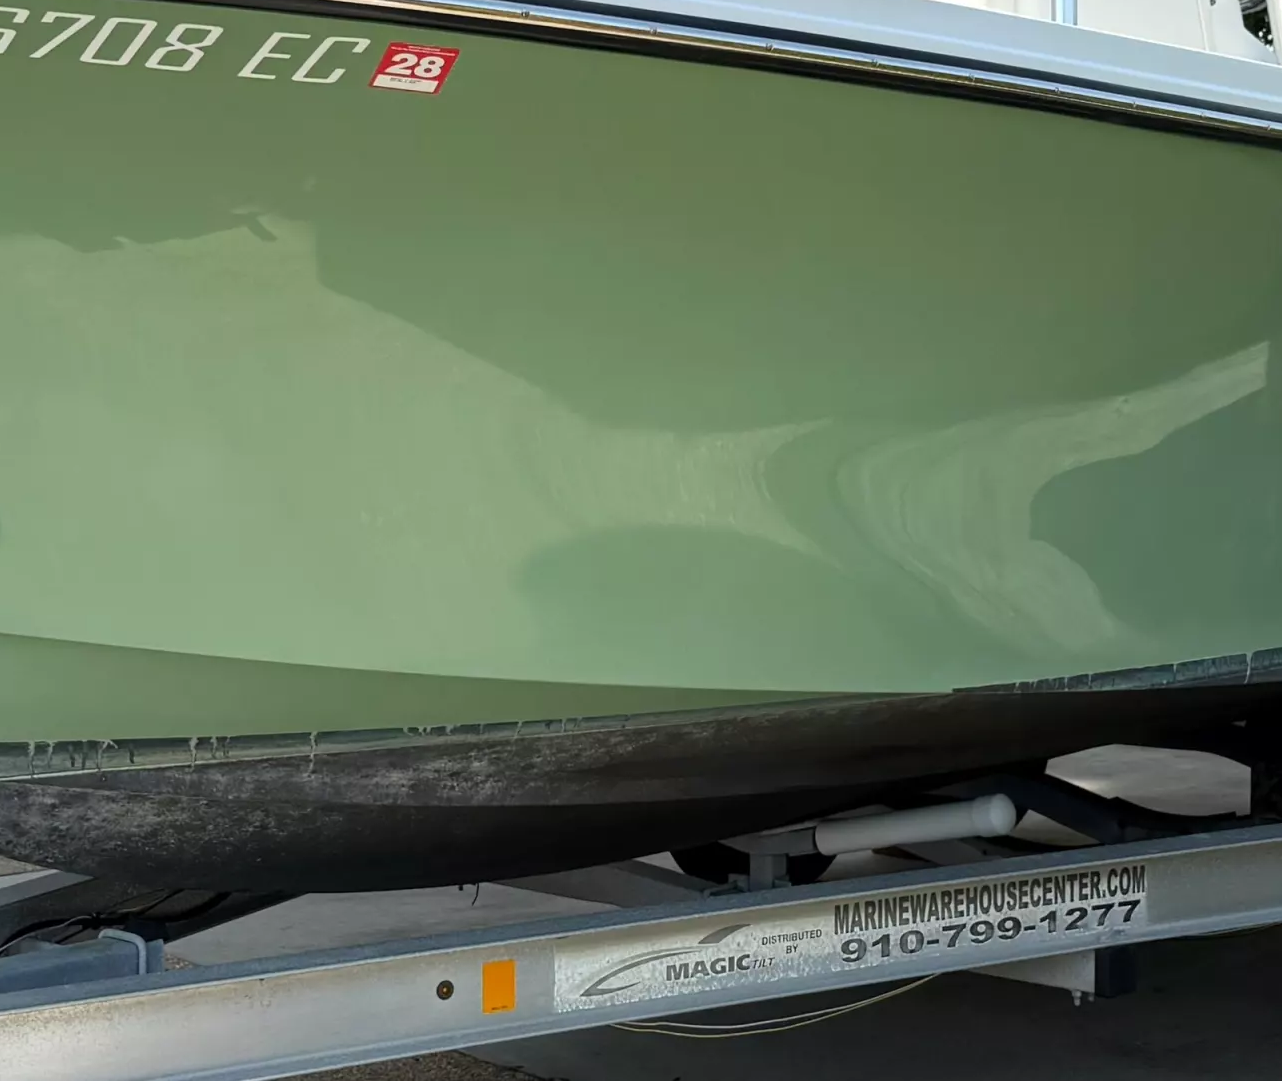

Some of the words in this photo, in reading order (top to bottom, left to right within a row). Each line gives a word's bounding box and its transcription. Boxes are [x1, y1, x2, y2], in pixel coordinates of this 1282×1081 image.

[237, 32, 371, 85] EC
[384, 53, 445, 78] 28
[834, 865, 1146, 935] MARINEWAREHOUSECENTER.COM
[761, 928, 823, 946] DISTRIBUTED
[840, 899, 1141, 963] 910-799-1277
[785, 944, 799, 954] BY
[665, 953, 751, 982] MAGIC
[752, 957, 776, 970] TILT
